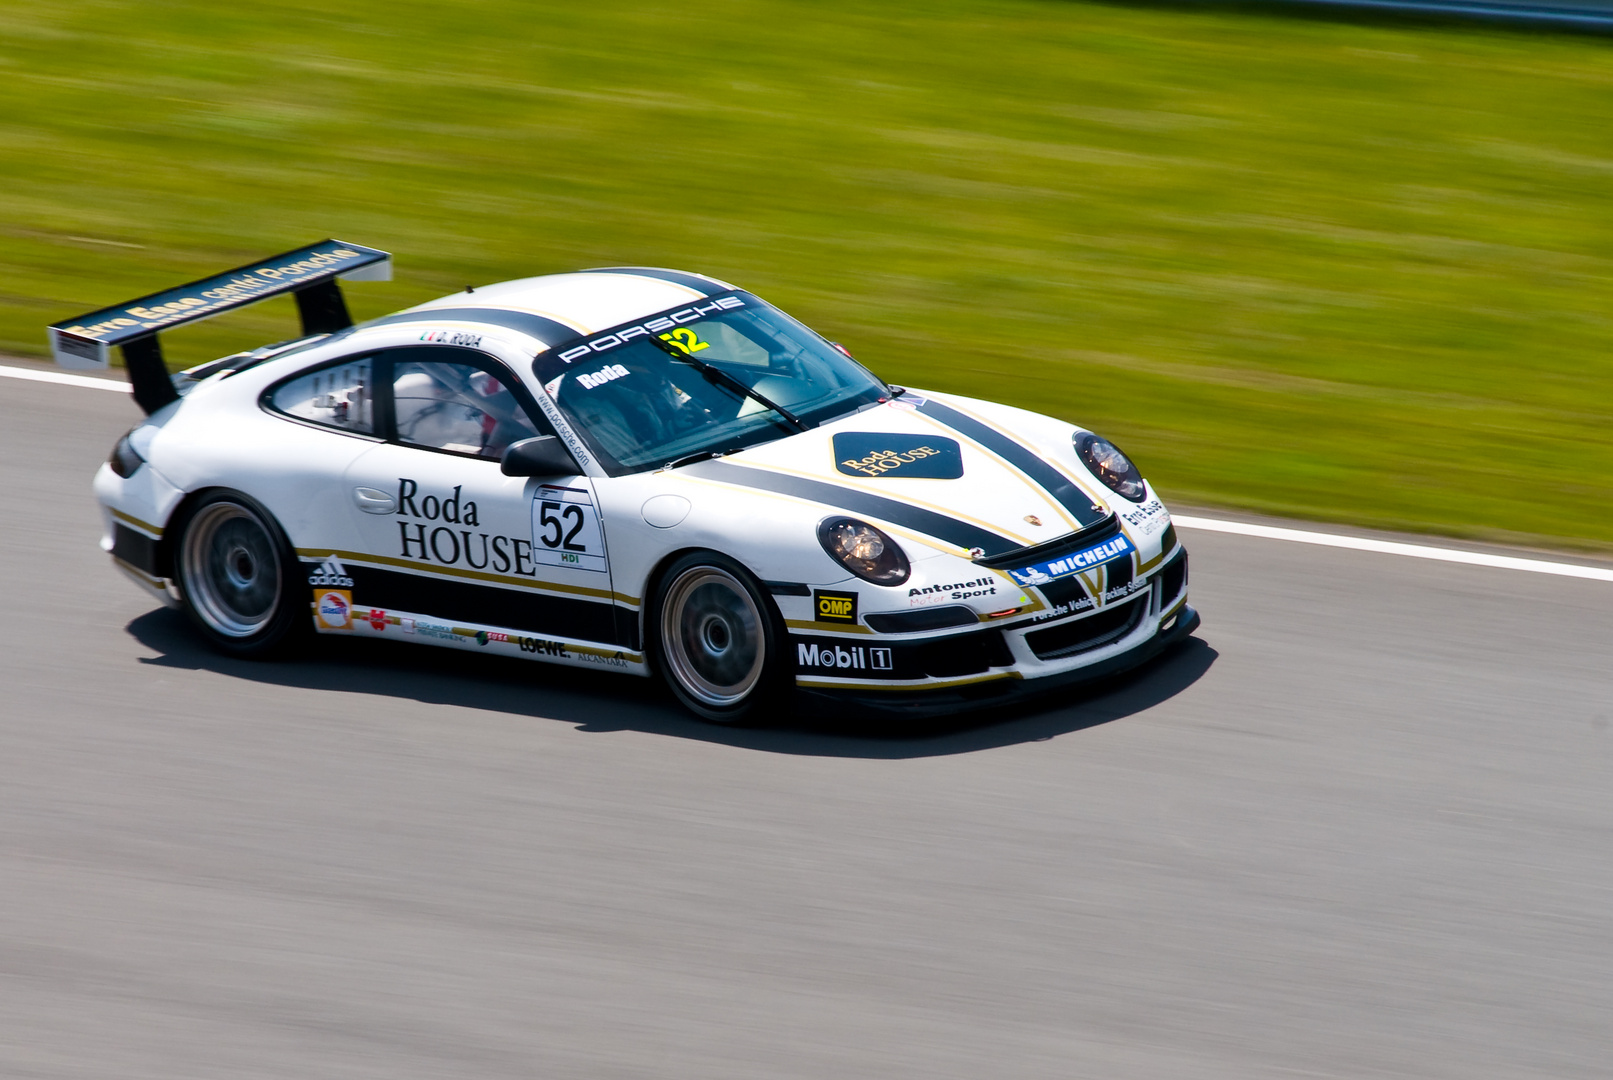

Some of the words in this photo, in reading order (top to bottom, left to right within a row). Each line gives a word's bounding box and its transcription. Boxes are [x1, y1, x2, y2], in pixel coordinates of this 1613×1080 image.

[254, 249, 360, 280] Porsche
[450, 332, 482, 348] RODA
[557, 295, 746, 364] PORSCHE
[576, 363, 631, 390] Roda
[538, 394, 590, 466] www.porsche.com
[842, 449, 898, 470] Roda
[858, 446, 941, 477] HOUSE
[396, 477, 480, 527] Roda
[540, 501, 586, 552] 52
[397, 520, 536, 576] HOUSE
[561, 553, 579, 563] HDI
[1048, 536, 1128, 575] MICHELIN
[308, 573, 354, 587] adidas
[908, 577, 995, 597] Antonelli
[819, 600, 852, 615] OMP
[910, 594, 945, 607] Motor
[951, 587, 997, 600] Sport
[1032, 605, 1068, 621] Porsche
[798, 643, 866, 669] Mobil
